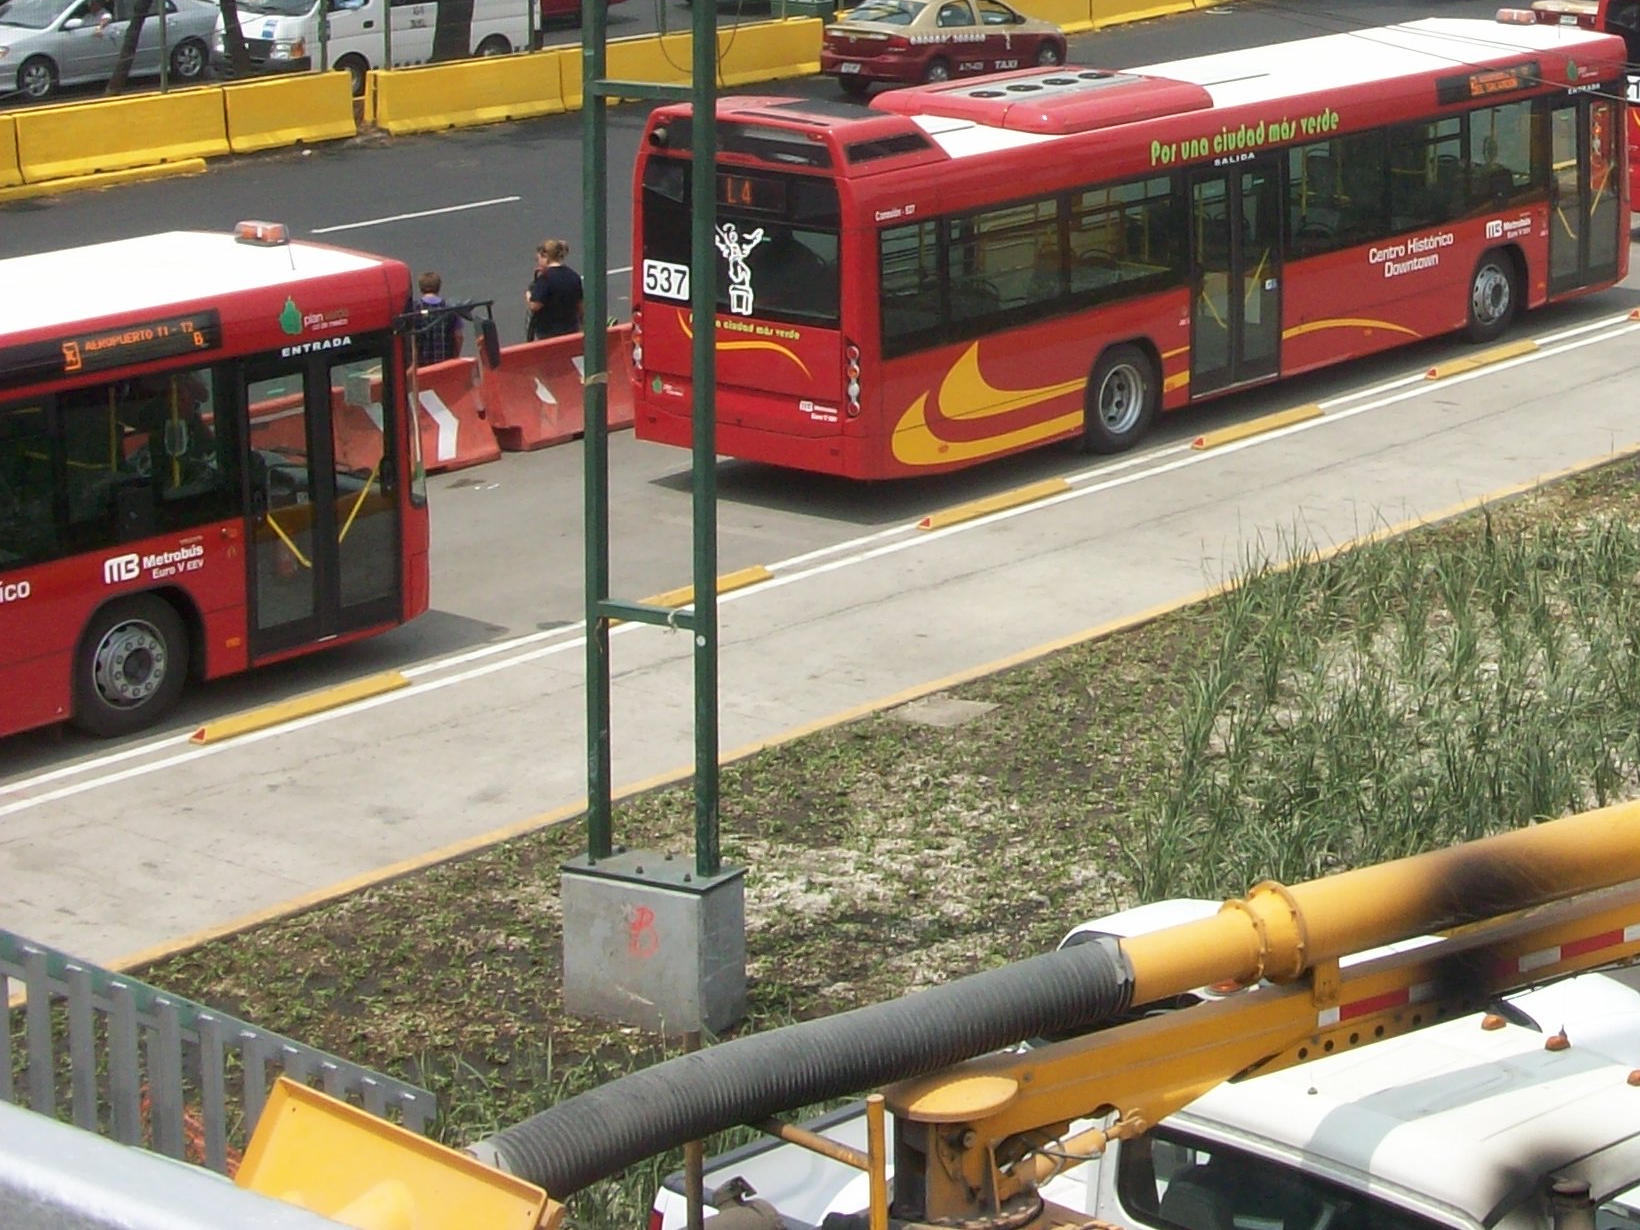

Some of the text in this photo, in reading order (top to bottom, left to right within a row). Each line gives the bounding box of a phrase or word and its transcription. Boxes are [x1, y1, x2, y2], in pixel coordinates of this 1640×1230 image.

[1151, 108, 1339, 166] Por una ciudad más verde
[1213, 152, 1255, 166] SALIDA
[1369, 232, 1454, 264] Centro Histórico
[1384, 254, 1438, 277] Downtown
[645, 264, 688, 296] 537
[85, 329, 153, 351] AEROPUERTO
[281, 336, 352, 357] ENTRADA
[143, 544, 204, 569] Metrobús
[152, 566, 176, 579] Euro
[177, 561, 185, 573] V
